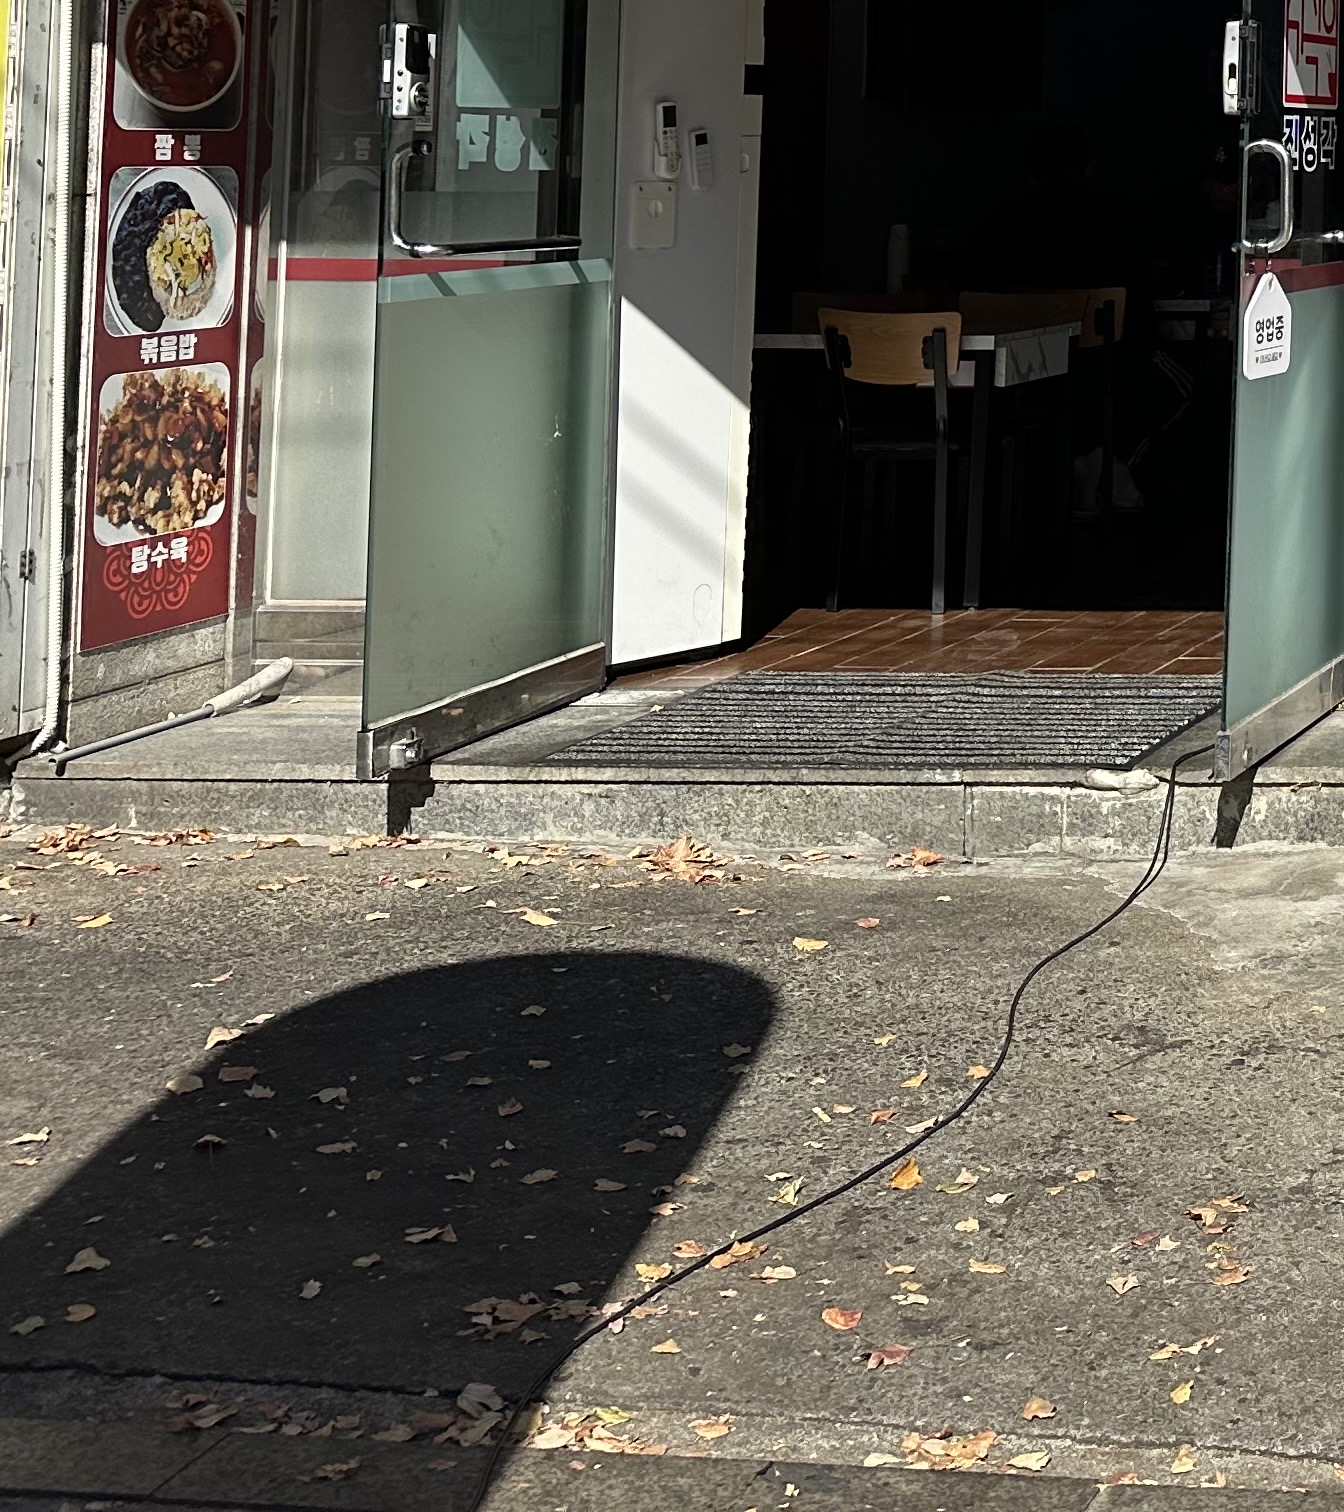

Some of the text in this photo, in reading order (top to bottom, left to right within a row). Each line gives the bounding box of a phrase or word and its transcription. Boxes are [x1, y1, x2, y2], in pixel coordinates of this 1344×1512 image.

[1282, 115, 1338, 172] 진성각
[1255, 315, 1285, 345] 영업중
[139, 334, 197, 363] 볶음밥
[130, 537, 189, 574] 탕수육
